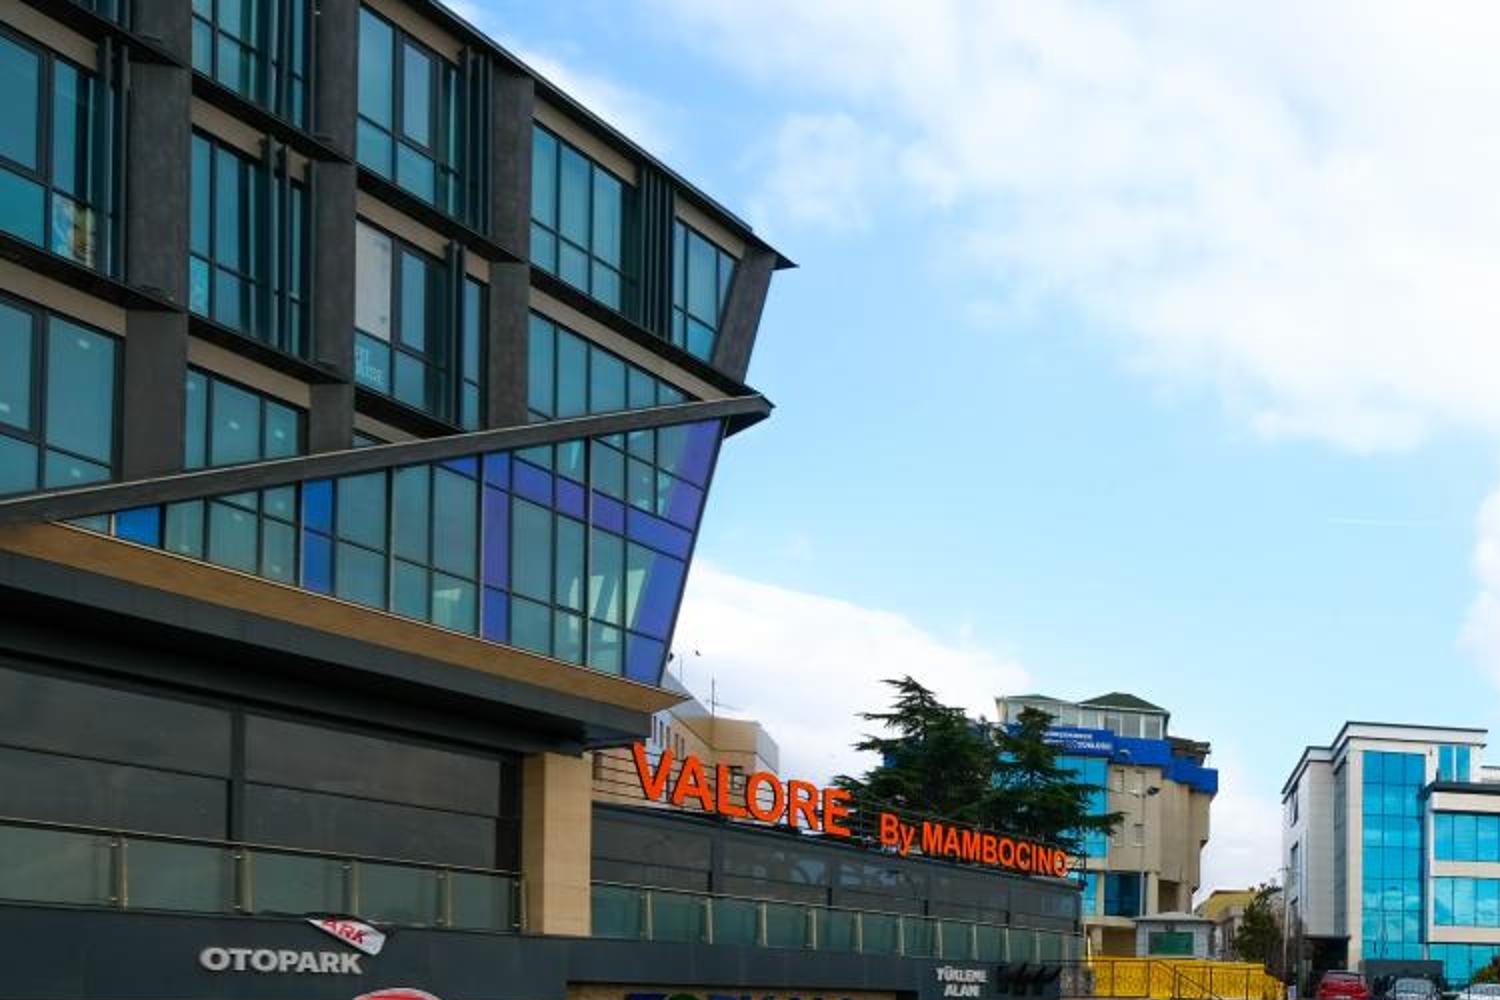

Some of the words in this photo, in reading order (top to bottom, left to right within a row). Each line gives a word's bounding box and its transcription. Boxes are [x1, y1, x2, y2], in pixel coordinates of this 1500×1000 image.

[632, 740, 853, 838] VALORE
[879, 811, 916, 858] By
[921, 819, 1069, 877] MAMBOCINO
[200, 946, 363, 975] OTOPARK
